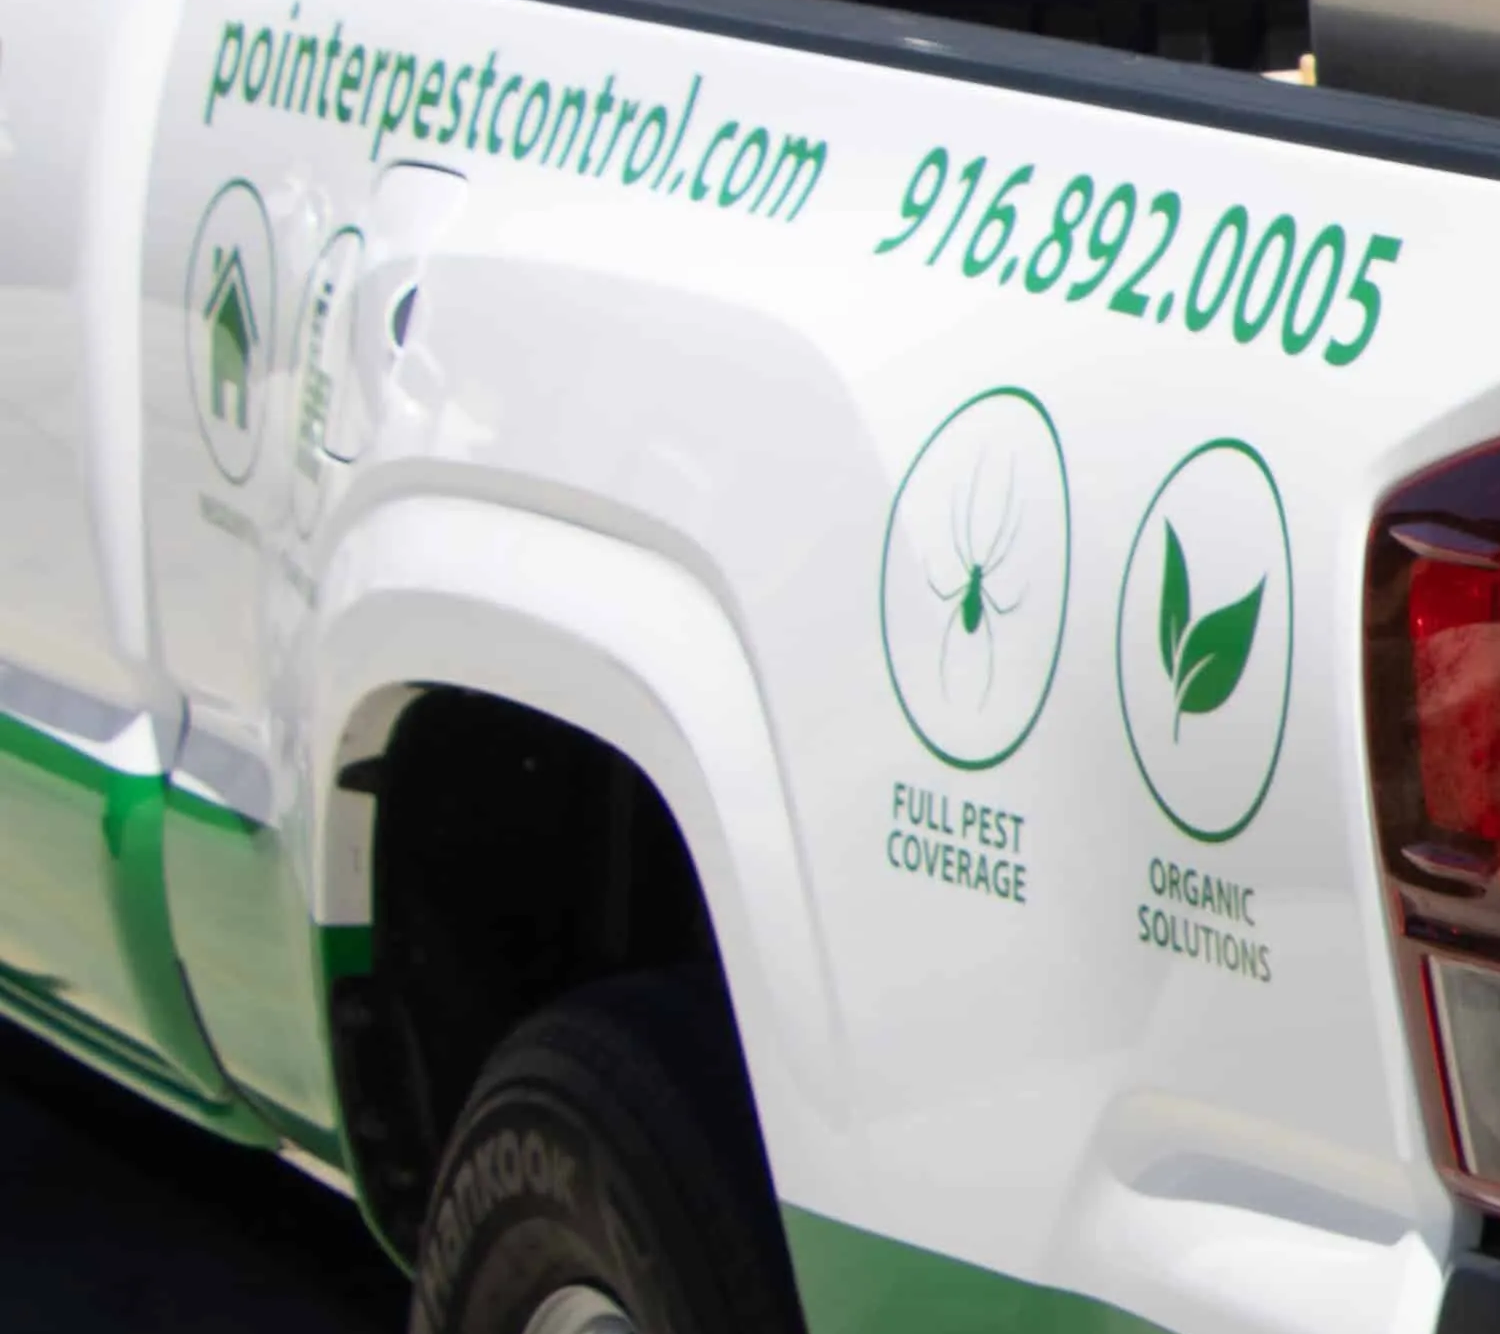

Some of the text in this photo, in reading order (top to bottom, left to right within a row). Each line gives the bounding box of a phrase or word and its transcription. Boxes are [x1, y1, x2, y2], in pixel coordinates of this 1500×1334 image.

[206, 3, 828, 224] pointerpestcontrol.com
[875, 145, 1403, 368] 916.892.0005
[892, 781, 1025, 854] FULL PEST
[886, 829, 1028, 905] COVERAGE
[1148, 856, 1256, 927] ORGANIC
[1137, 903, 1273, 984] SOLUTIONS
